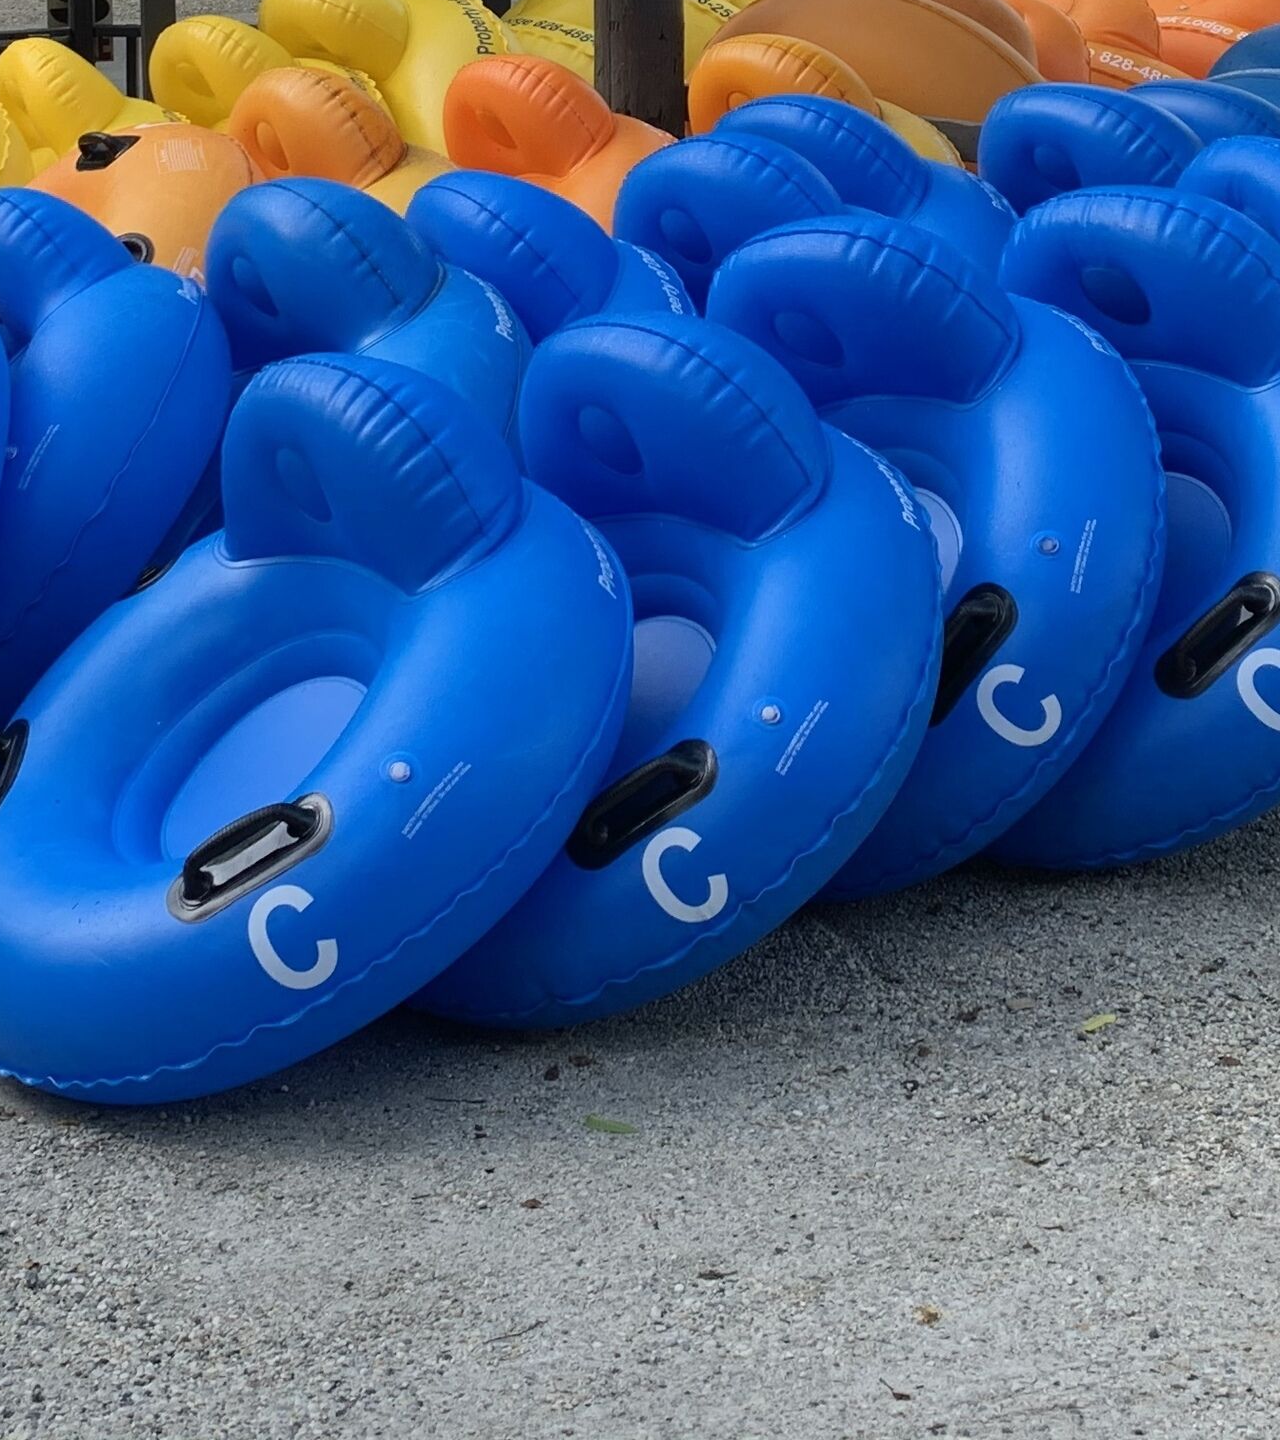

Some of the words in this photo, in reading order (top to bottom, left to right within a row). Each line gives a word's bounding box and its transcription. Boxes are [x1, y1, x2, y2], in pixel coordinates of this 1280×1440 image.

[1182, 16, 1233, 35] Lodge
[977, 664, 1062, 748] C
[642, 827, 729, 924] C
[248, 885, 338, 989] C
